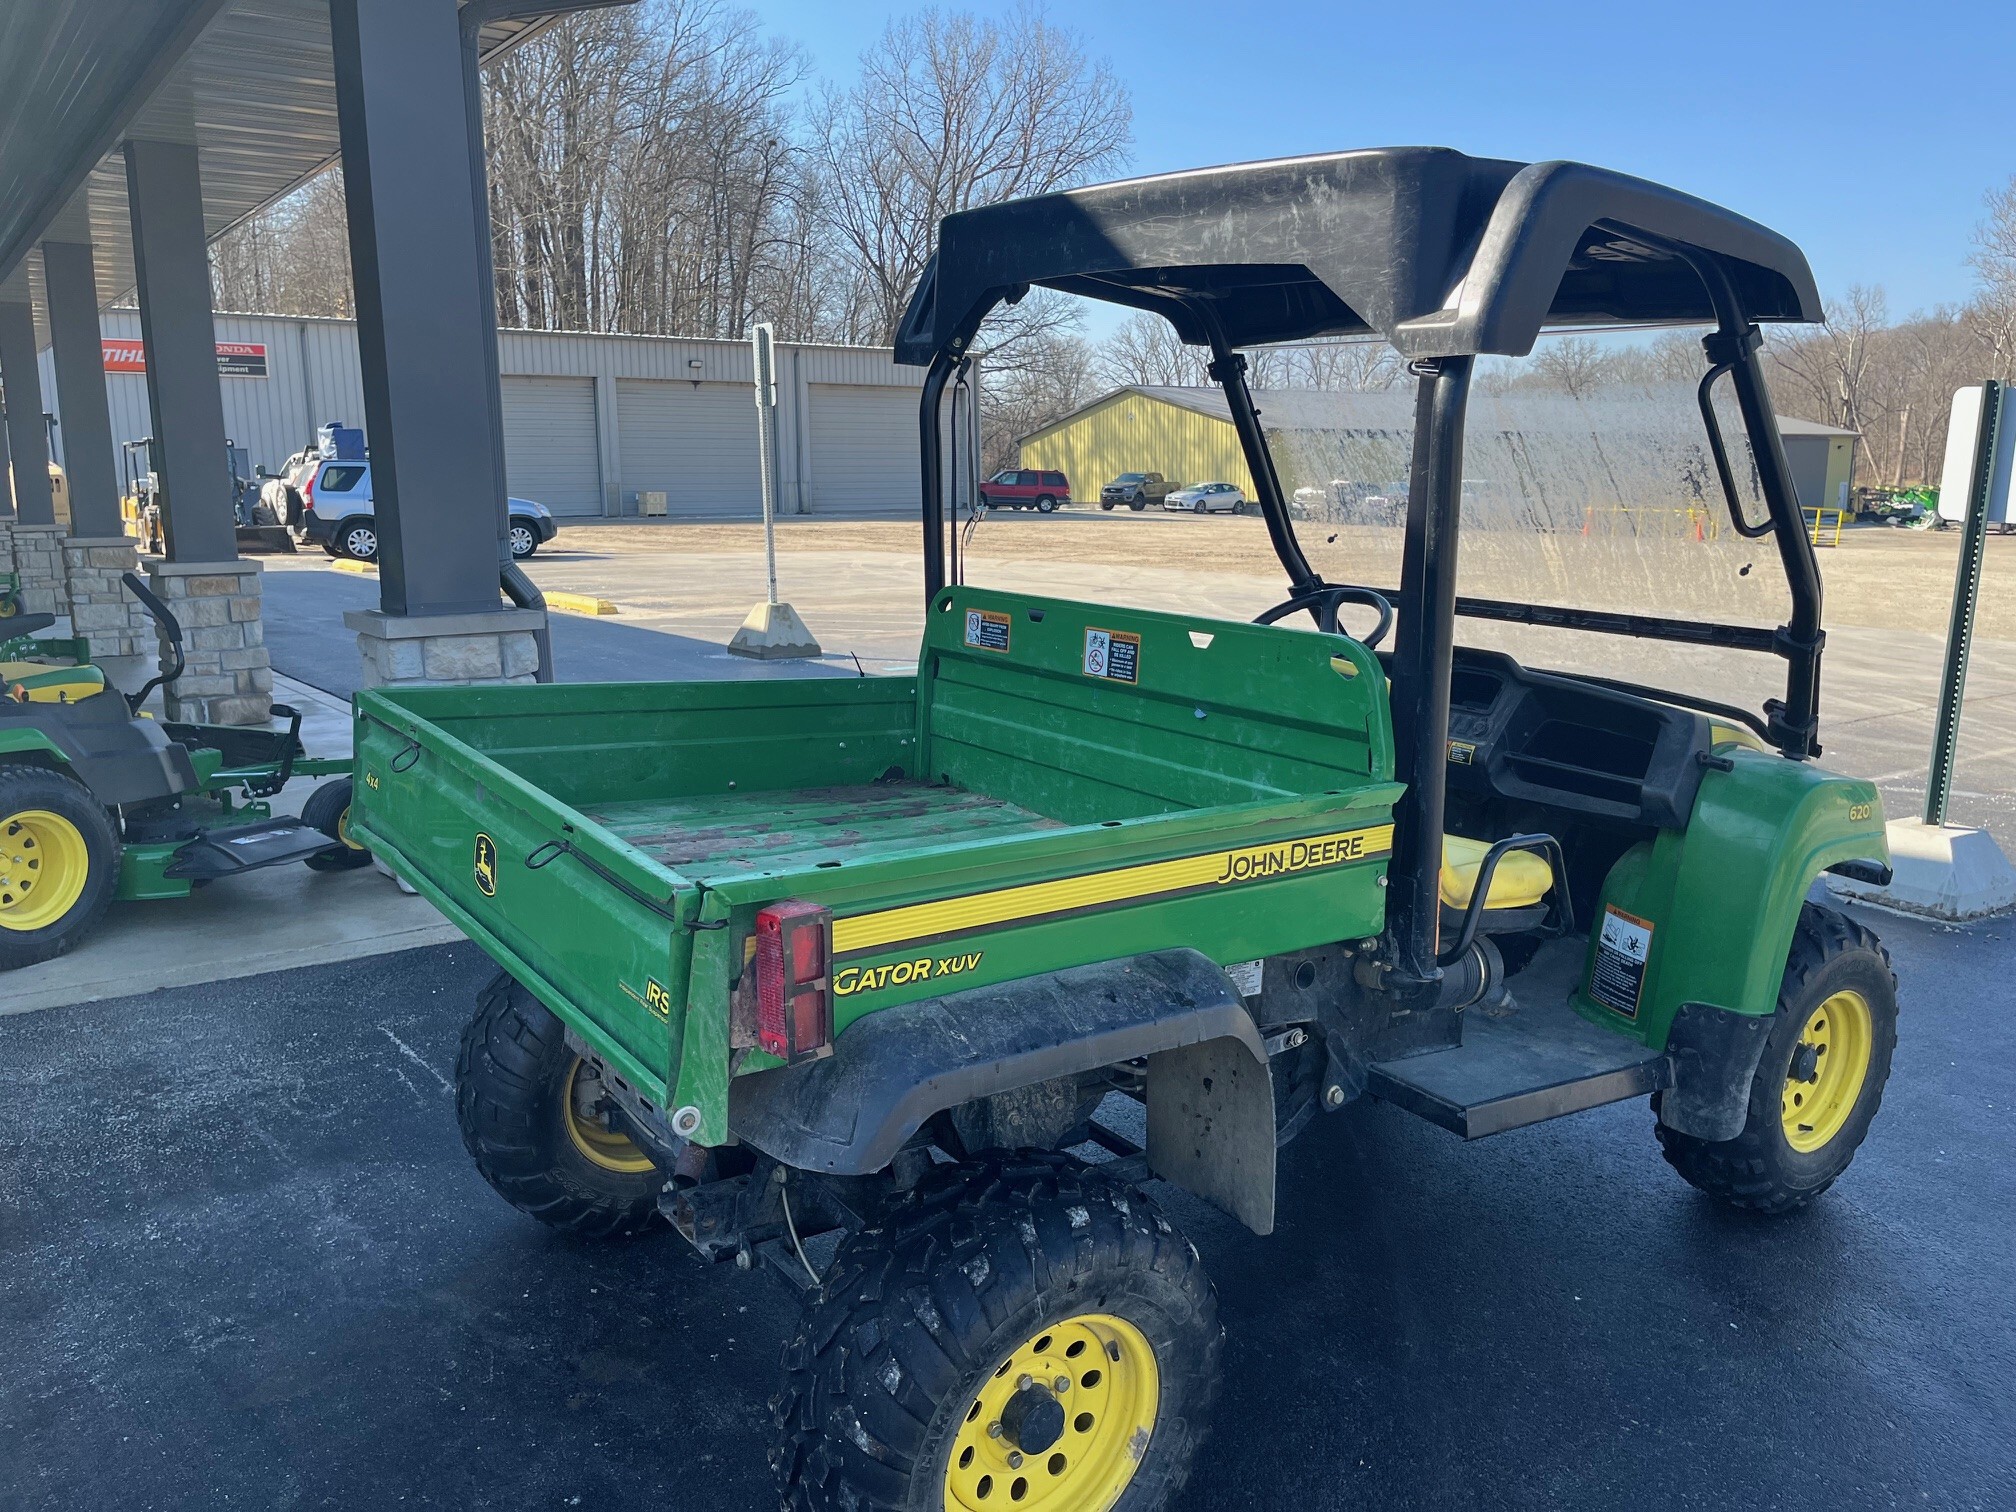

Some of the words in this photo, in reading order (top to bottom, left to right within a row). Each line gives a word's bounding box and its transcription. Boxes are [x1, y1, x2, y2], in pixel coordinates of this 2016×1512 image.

[102, 349, 146, 363] TIHL
[216, 345, 254, 354] ONDA
[1115, 632, 1138, 643] WARNING
[365, 772, 379, 791] 4x4
[1849, 804, 1870, 820] 620
[1218, 850, 1284, 882] JOHN
[1289, 836, 1364, 868] DEERE
[1617, 910, 1641, 925] WARNING
[833, 958, 932, 996] GATOR
[935, 952, 983, 976] XUV
[646, 980, 669, 1015] IRS
